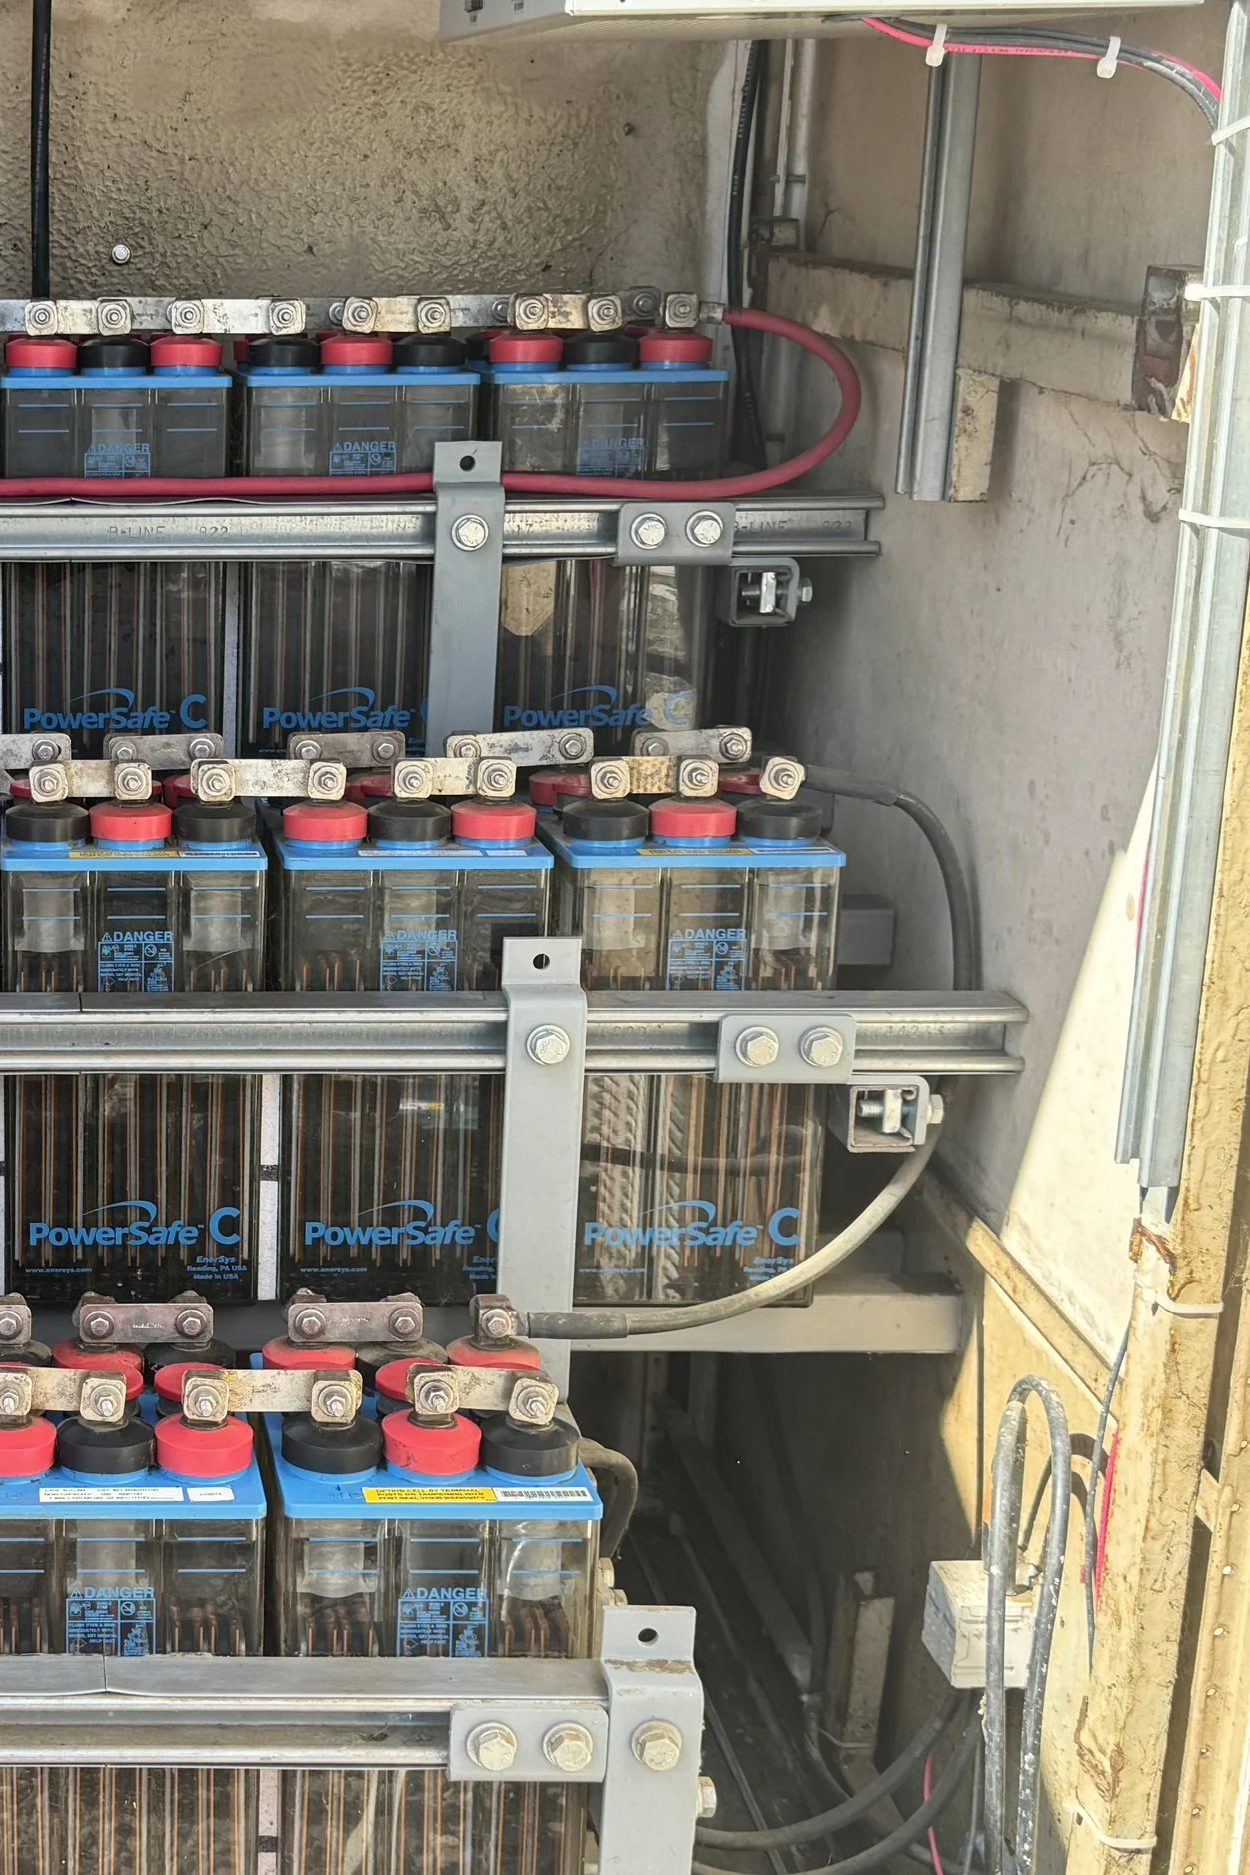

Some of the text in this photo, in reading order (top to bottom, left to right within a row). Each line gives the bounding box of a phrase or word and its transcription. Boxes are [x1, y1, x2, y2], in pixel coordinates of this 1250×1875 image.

[98, 443, 150, 453] DANGER
[343, 441, 396, 451] DANGER
[180, 694, 208, 729] C
[665, 690, 691, 725] C
[113, 931, 174, 942] DANGER
[396, 929, 458, 941] DANGER
[684, 928, 746, 940] DANGER
[208, 1206, 241, 1245] C
[768, 1207, 799, 1246] C
[196, 1255, 235, 1263] EnerSys
[84, 1586, 155, 1598] DANGER
[416, 1587, 487, 1599] DANGER
